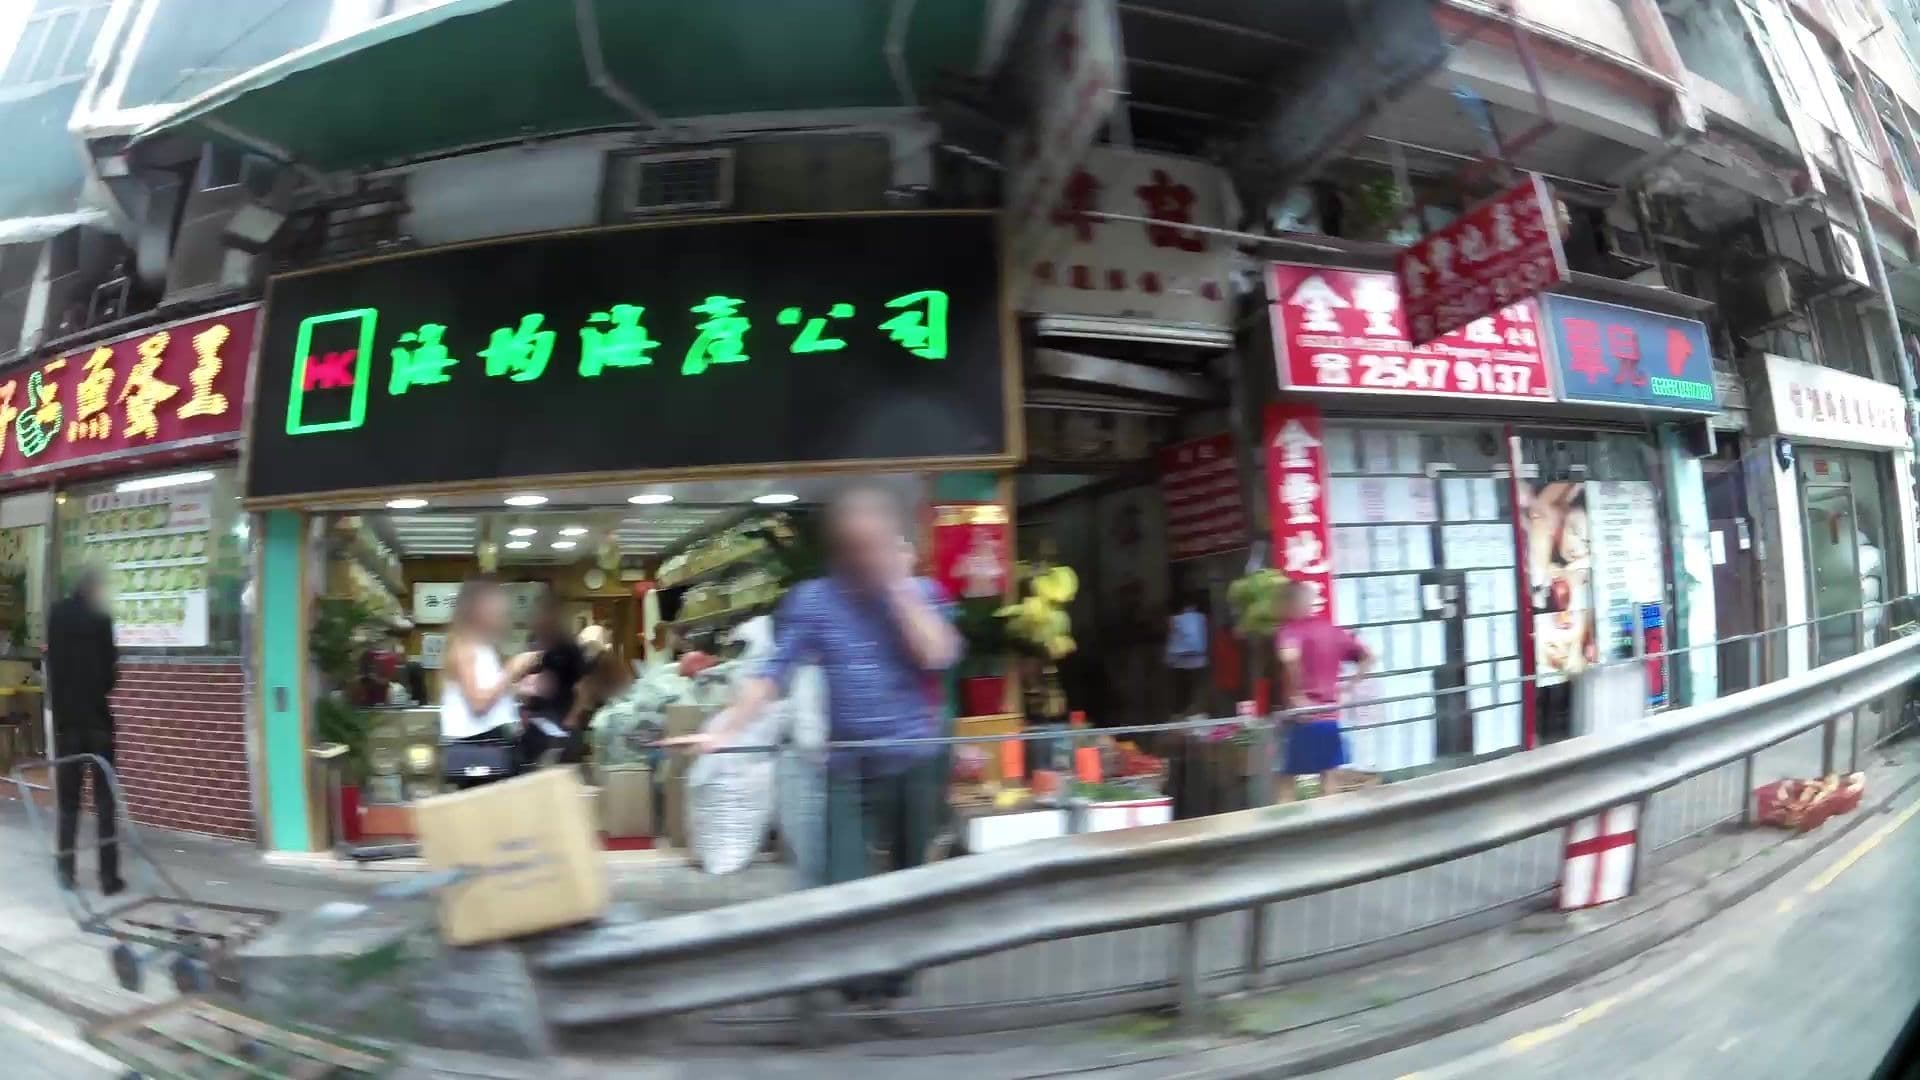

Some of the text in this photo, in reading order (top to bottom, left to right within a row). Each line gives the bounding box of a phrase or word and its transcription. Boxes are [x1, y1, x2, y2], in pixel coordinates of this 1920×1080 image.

[301, 348, 359, 392] HK
[1358, 354, 1532, 394] 2547 9137
